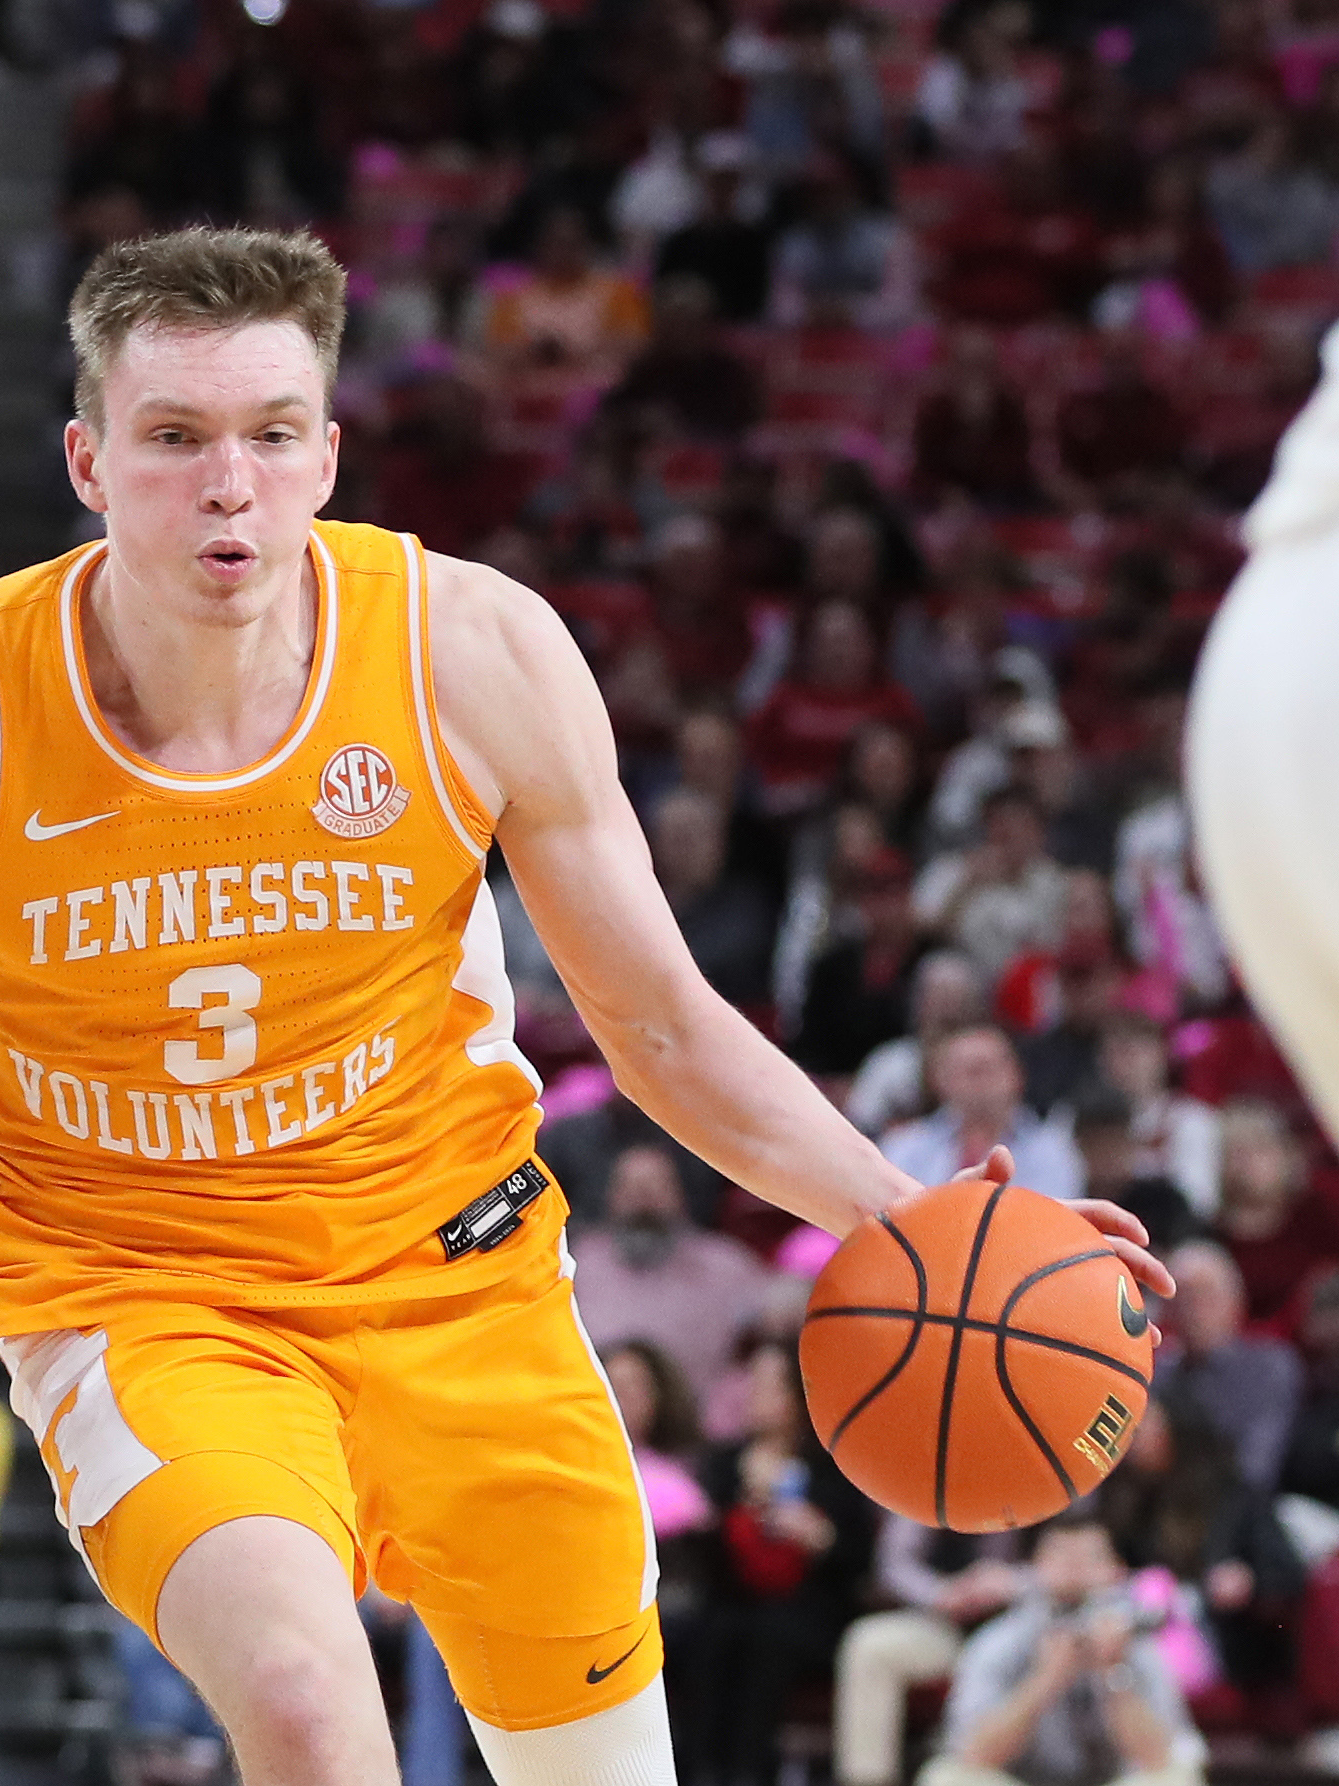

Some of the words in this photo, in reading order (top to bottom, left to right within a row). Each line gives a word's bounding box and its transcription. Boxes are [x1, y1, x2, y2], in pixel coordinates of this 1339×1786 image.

[324, 804, 401, 837] GRADUATE
[327, 749, 389, 814] SEC
[21, 860, 414, 965] TENNESSEE
[163, 963, 260, 1086] 3
[8, 1024, 399, 1162] VOLUNTEERS
[506, 1173, 528, 1195] 48
